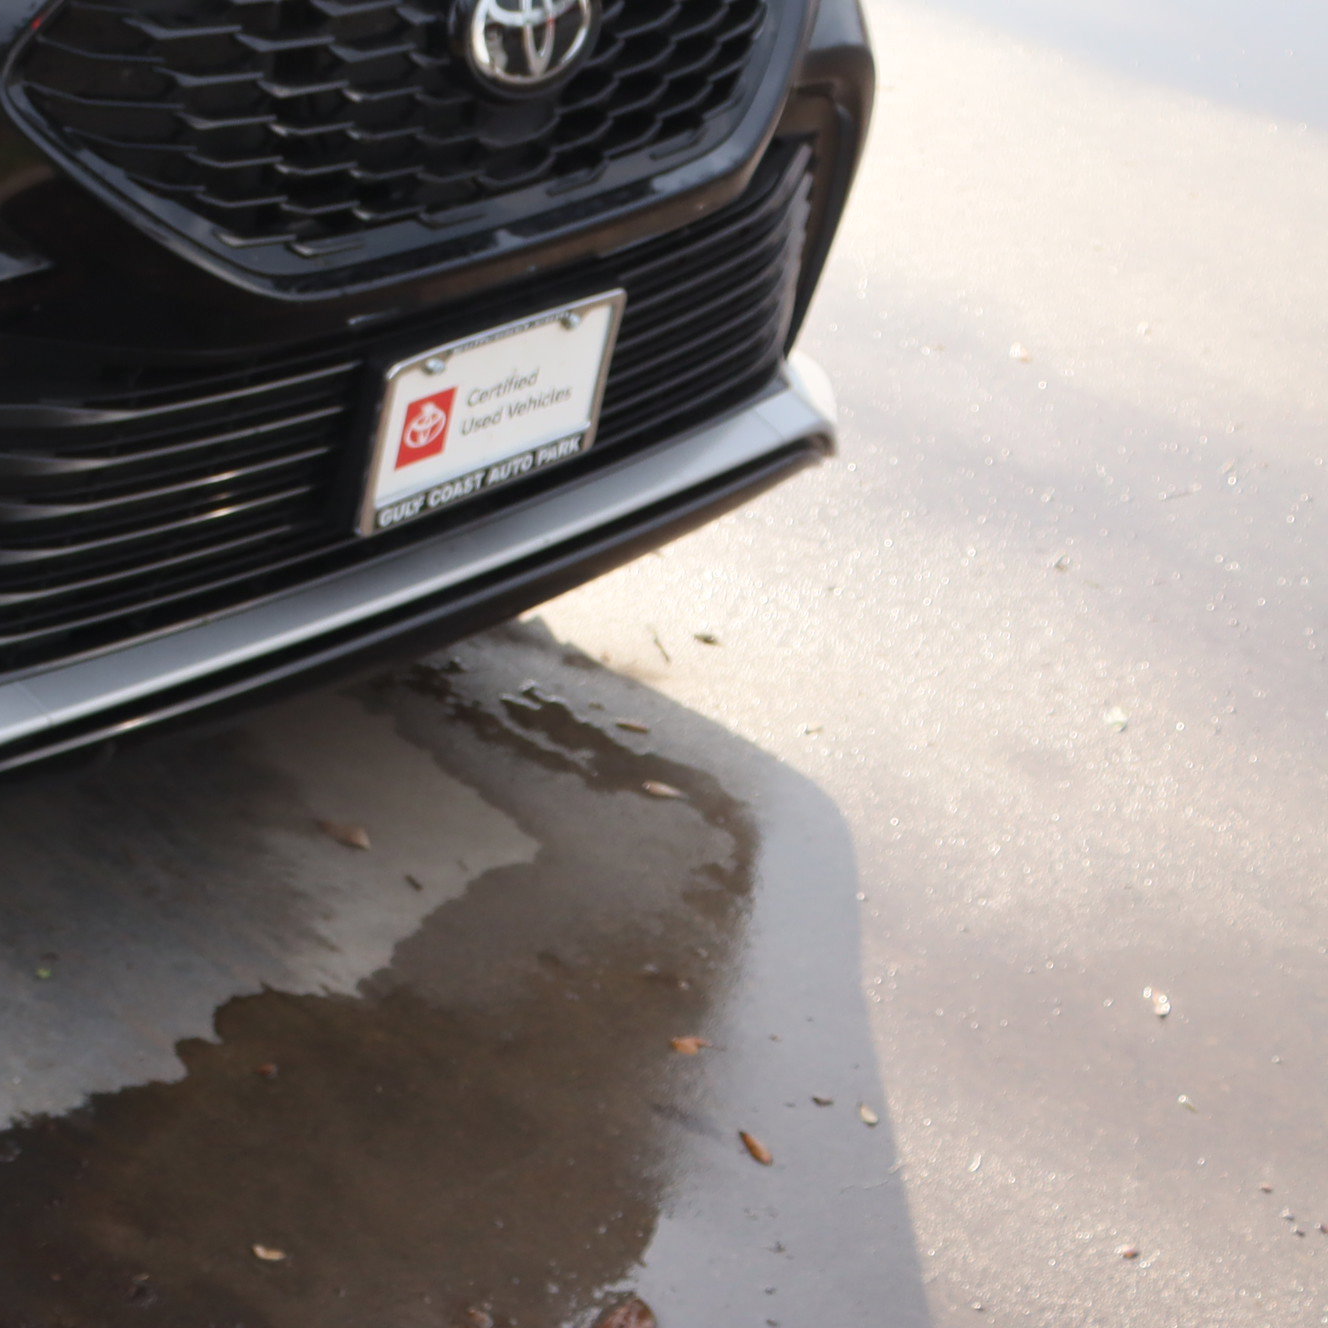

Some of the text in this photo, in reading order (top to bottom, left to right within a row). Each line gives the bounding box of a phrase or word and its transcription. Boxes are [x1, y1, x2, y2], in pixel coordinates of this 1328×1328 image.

[461, 387, 572, 435] Used Vehicles
[467, 370, 539, 407] Certified
[428, 473, 486, 506] COAST
[488, 454, 533, 484] AUTO
[537, 436, 581, 466] PARK
